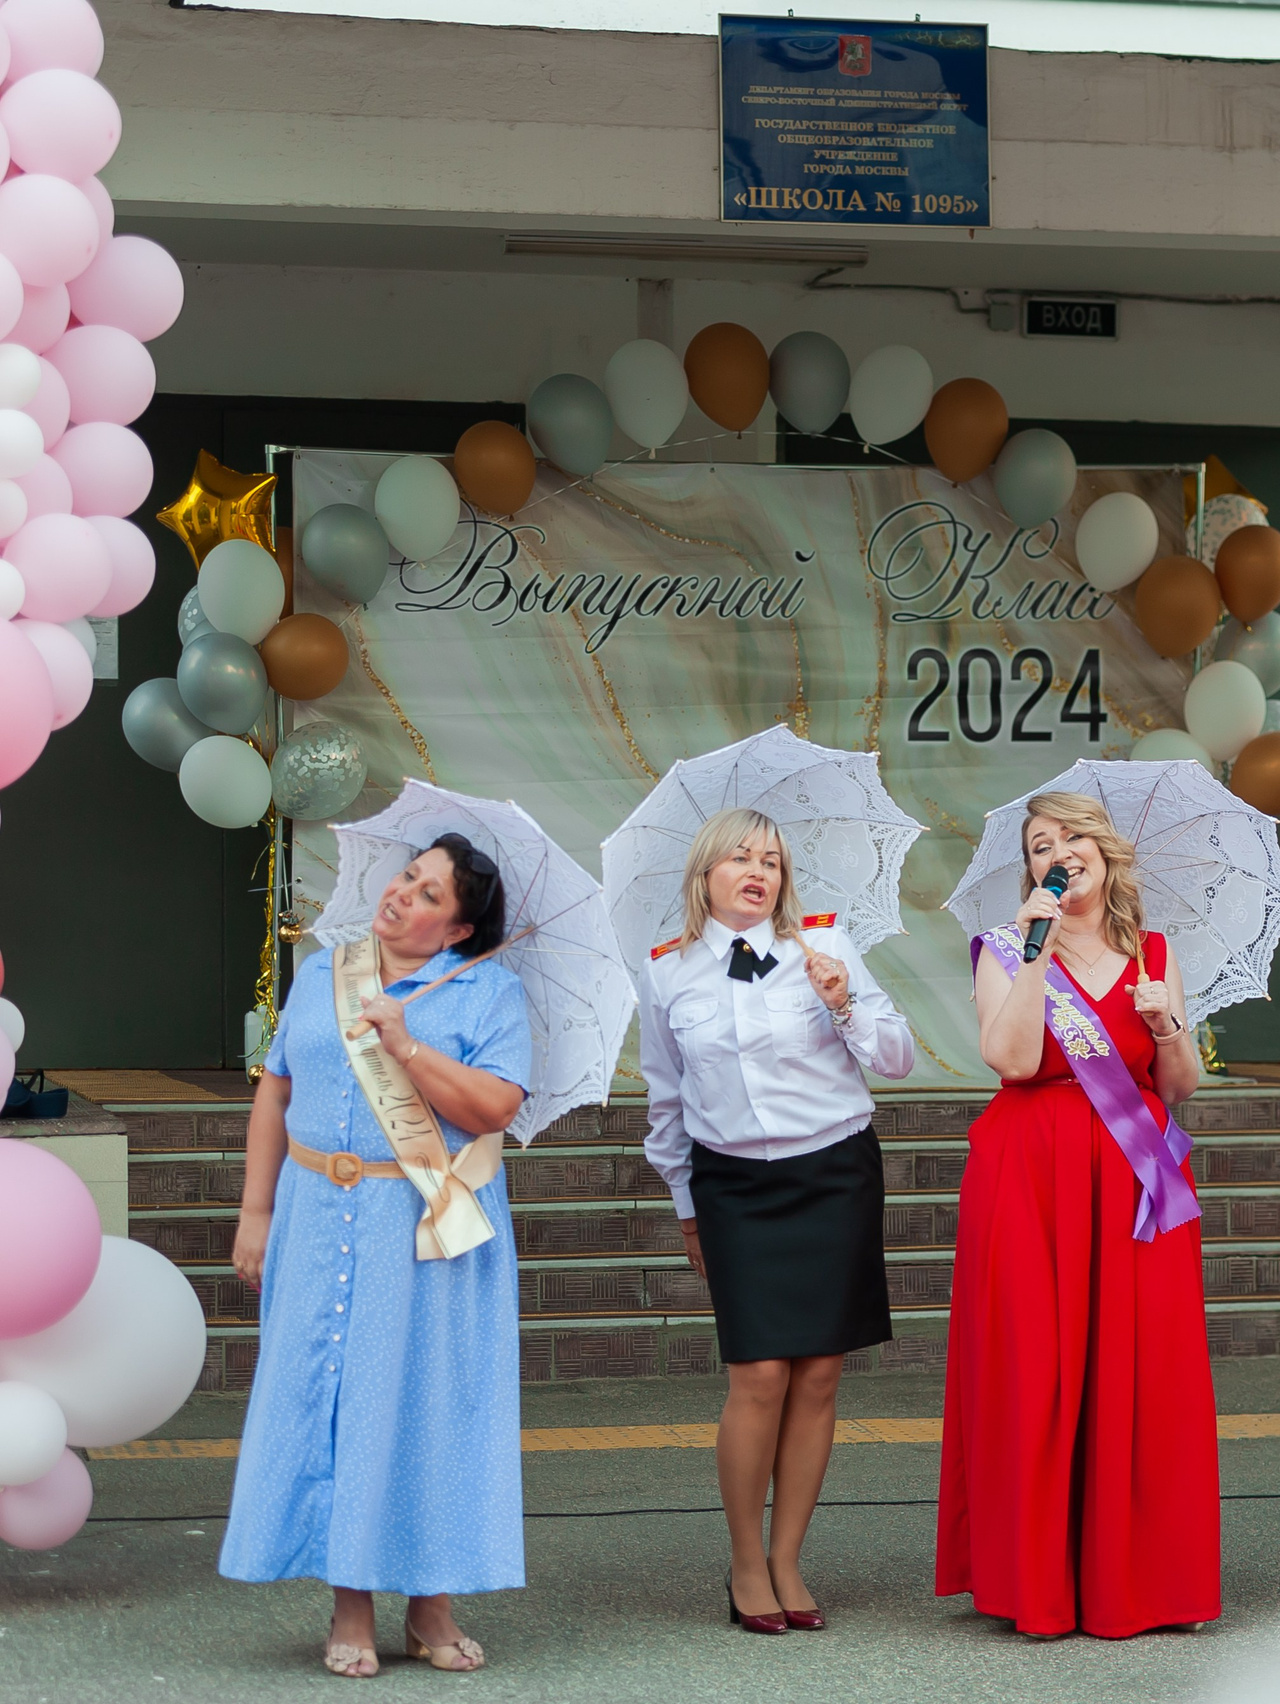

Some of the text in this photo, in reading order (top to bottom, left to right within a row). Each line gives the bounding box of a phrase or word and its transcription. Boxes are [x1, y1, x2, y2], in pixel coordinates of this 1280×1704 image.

[748, 85, 961, 100] ДЕПАРТАМЕНТ ОБРАЗОВАНИЯ ГОРОДА МОСКВЫ
[741, 95, 836, 107] СЕВЕРО-ВОСТОЧНЫЙ
[838, 99, 938, 110] АДМИНИСТРАТИВНЫЙ
[754, 118, 957, 135] ГОСУДАРСТВЕННОЕ БЮДЖЕТНОЕ
[777, 133, 935, 149] ОБЩЕОБРАЗОВАТЕЛЬНОЕ
[813, 149, 899, 162] УЧРЕЖДЕНИЕ
[803, 163, 910, 177] ГОРОДА МОСКВЫ
[733, 186, 980, 214] «ШКОЛА № 1095»
[1042, 305, 1103, 333] ВХОД
[389, 497, 815, 654] Выпускной
[906, 648, 1109, 743] 2024
[378, 1090, 434, 1141] 2024
